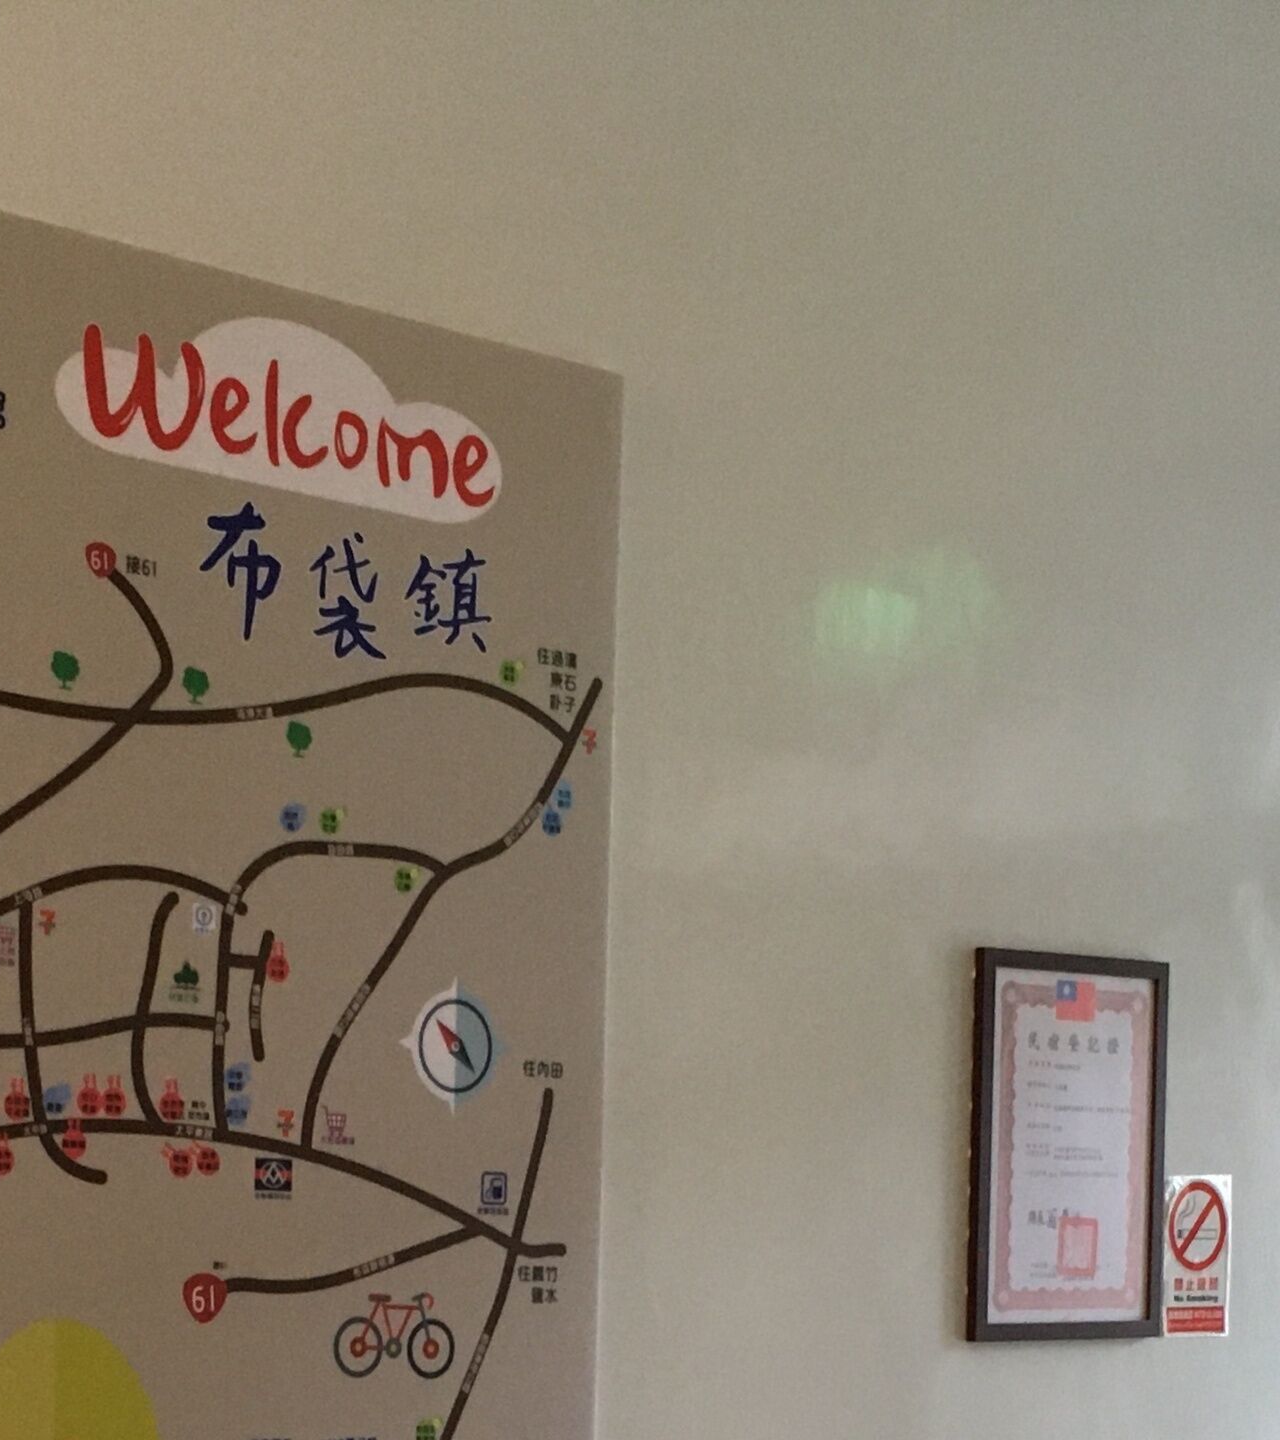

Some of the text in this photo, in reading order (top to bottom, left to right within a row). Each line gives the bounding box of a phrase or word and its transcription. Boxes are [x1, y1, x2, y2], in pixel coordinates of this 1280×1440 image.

[83, 324, 495, 506] Welcome
[90, 549, 108, 571] 61
[199, 502, 492, 659] 布袋鎮
[192, 1284, 216, 1313] 61
